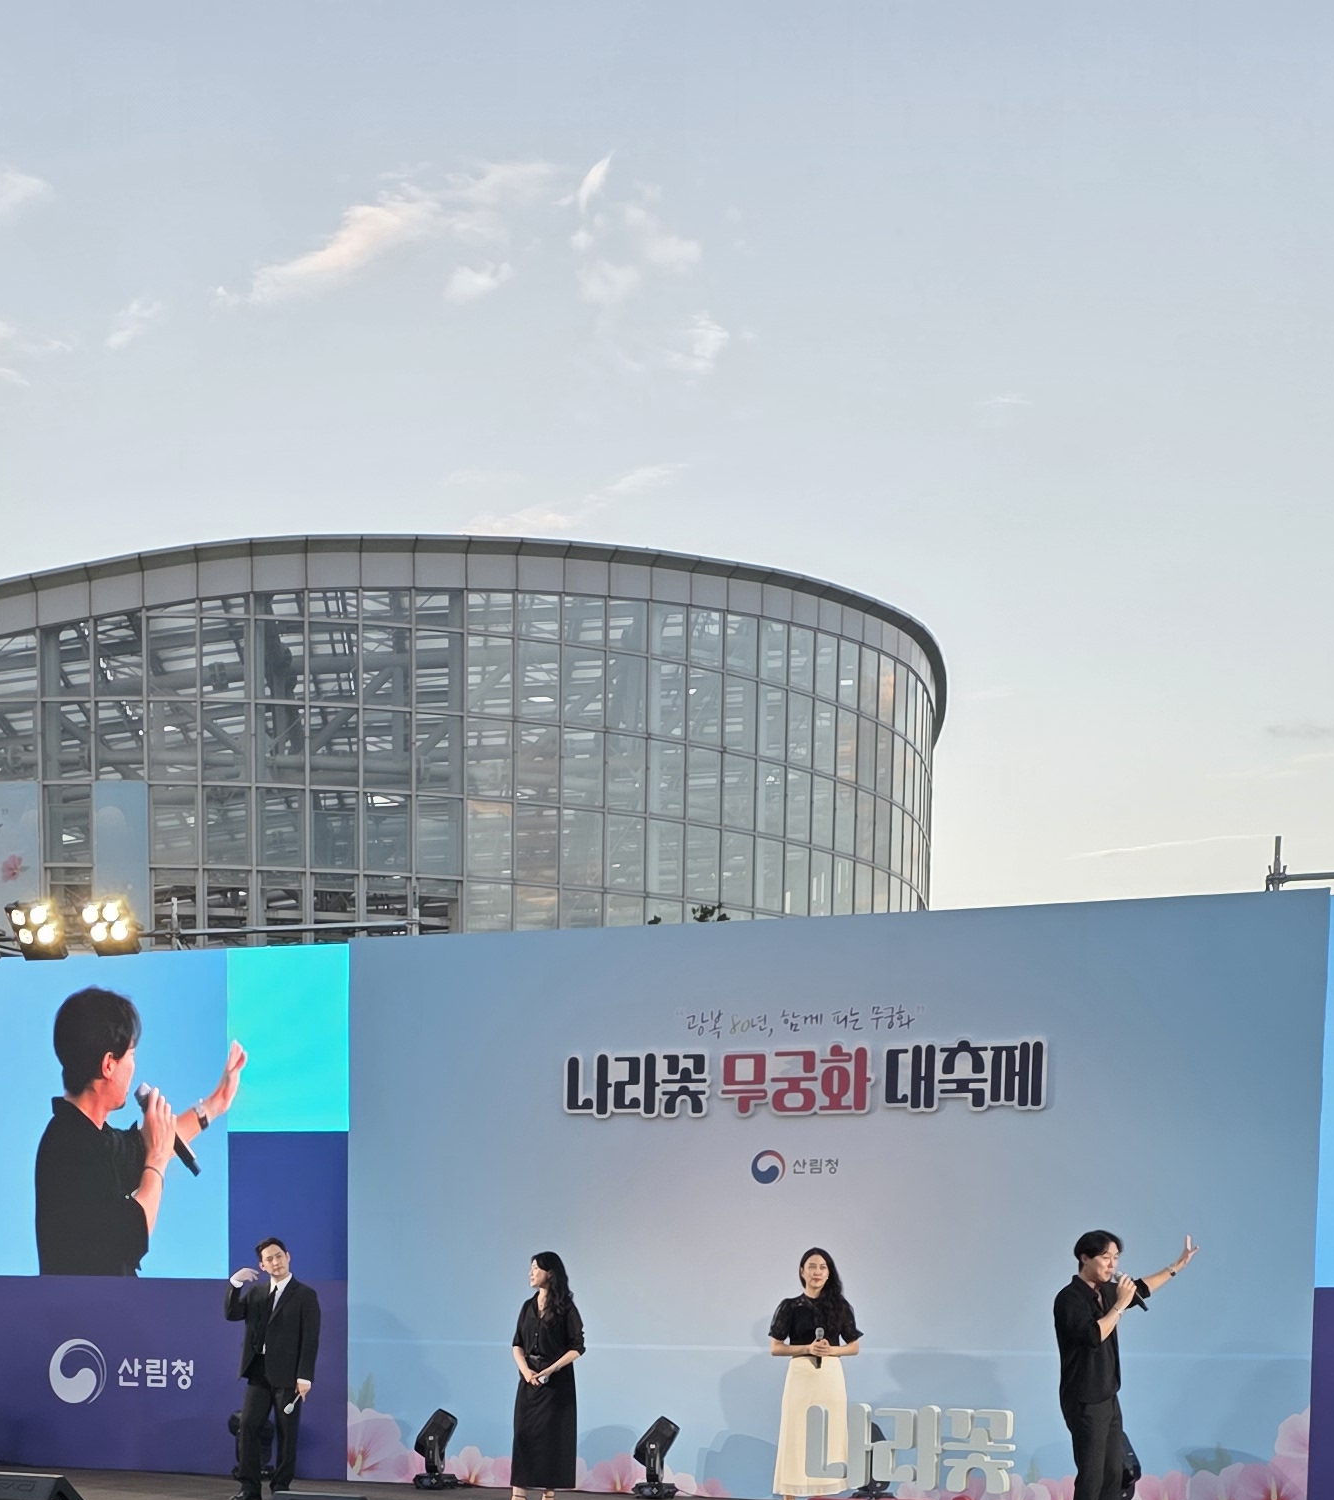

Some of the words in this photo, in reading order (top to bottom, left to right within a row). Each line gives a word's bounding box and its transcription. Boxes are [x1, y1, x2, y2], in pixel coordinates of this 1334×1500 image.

[780, 1009, 823, 1032] 함께
[831, 1007, 863, 1030] 피는
[566, 1053, 708, 1116] 나라꽃
[720, 1044, 872, 1114] 무궁화
[884, 1039, 1044, 1110] 대축제
[792, 1158, 840, 1175] 산림청
[117, 1357, 195, 1391] 산림청
[804, 1403, 1016, 1494] 나라꽃
